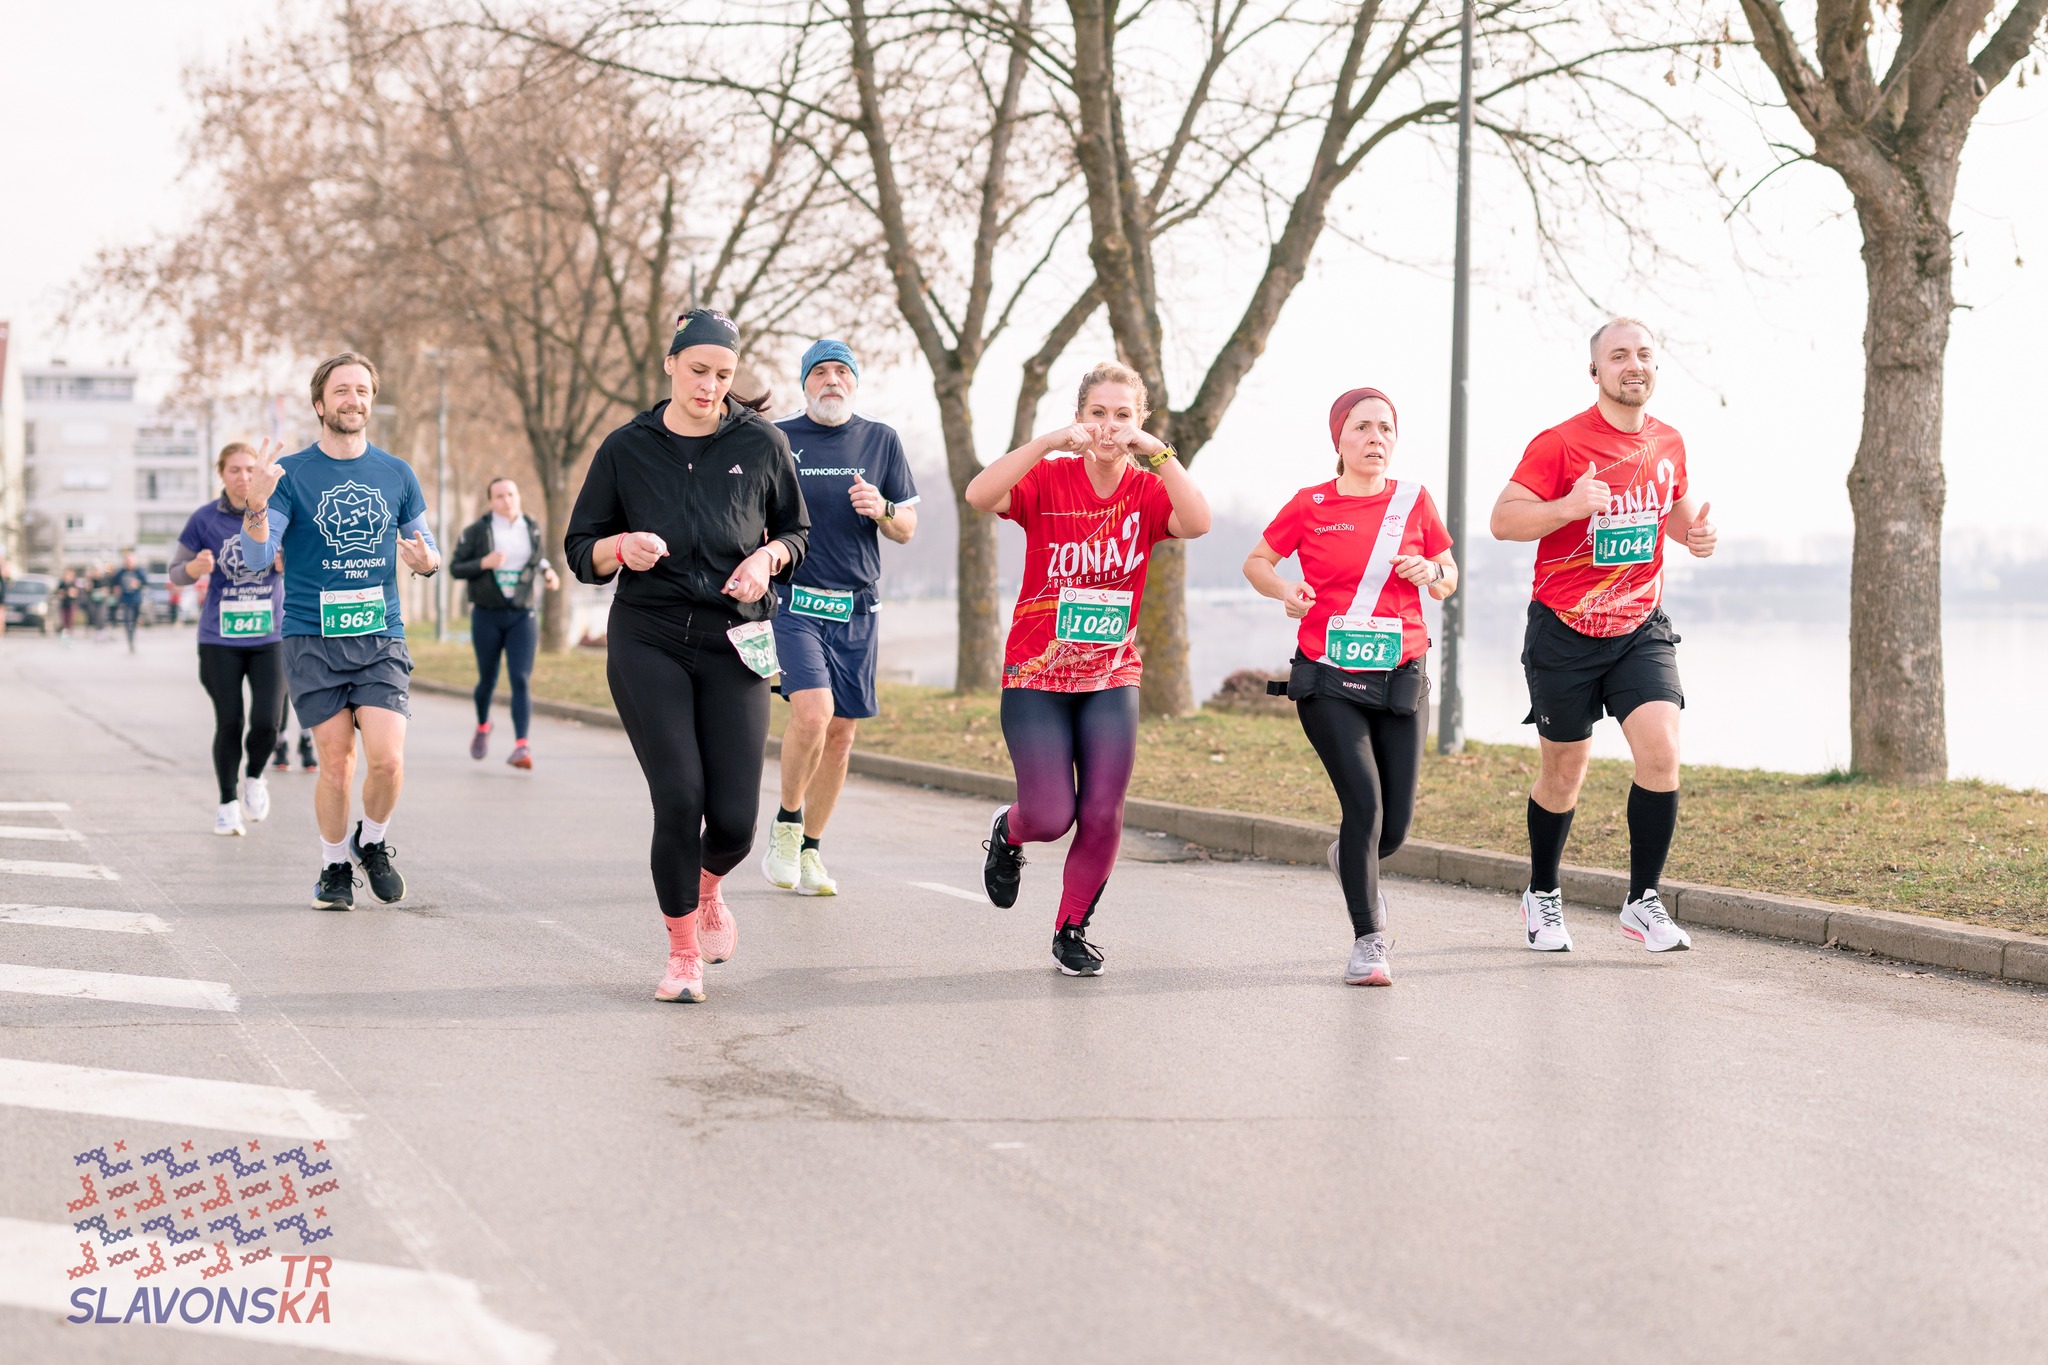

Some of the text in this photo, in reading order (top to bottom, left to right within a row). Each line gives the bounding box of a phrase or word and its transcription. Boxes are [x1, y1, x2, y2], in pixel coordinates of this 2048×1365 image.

[1656, 458, 1675, 518] 2
[1047, 511, 1145, 577] ZONA 2
[1607, 535, 1653, 557] 1044
[331, 557, 386, 569] SLAVONSKA
[344, 570, 369, 579] TRKA
[802, 596, 847, 613] 1049
[233, 617, 262, 632] 841
[340, 610, 375, 629] 963
[1070, 614, 1123, 635] 1020
[1345, 641, 1386, 661] 961
[1342, 681, 1367, 691] KIPRUN
